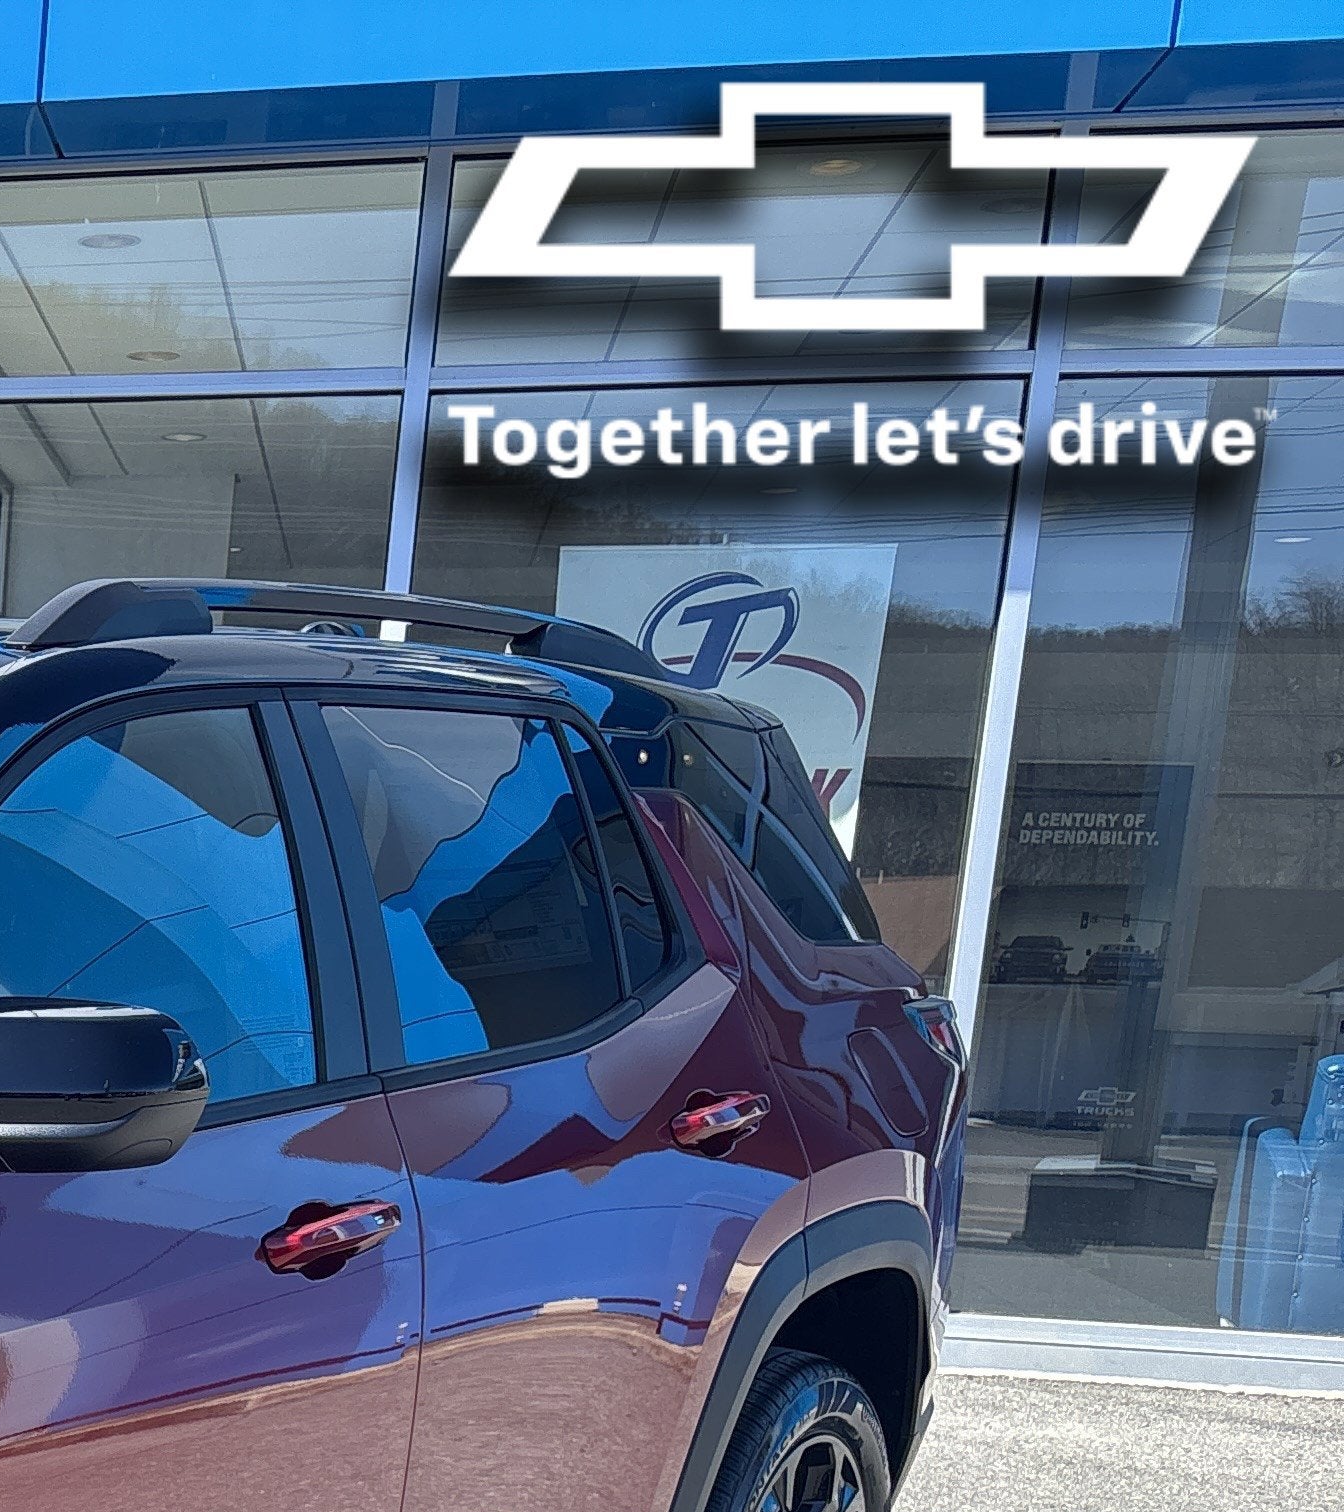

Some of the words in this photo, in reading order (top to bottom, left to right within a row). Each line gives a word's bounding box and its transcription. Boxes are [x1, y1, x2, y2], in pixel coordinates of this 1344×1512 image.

[1021, 812, 1034, 827] A
[1037, 812, 1120, 828] CENTURY
[1122, 813, 1147, 828] OF
[1018, 829, 1160, 846] DEPENDABILITY.
[1076, 1105, 1135, 1117] TRUCKS
